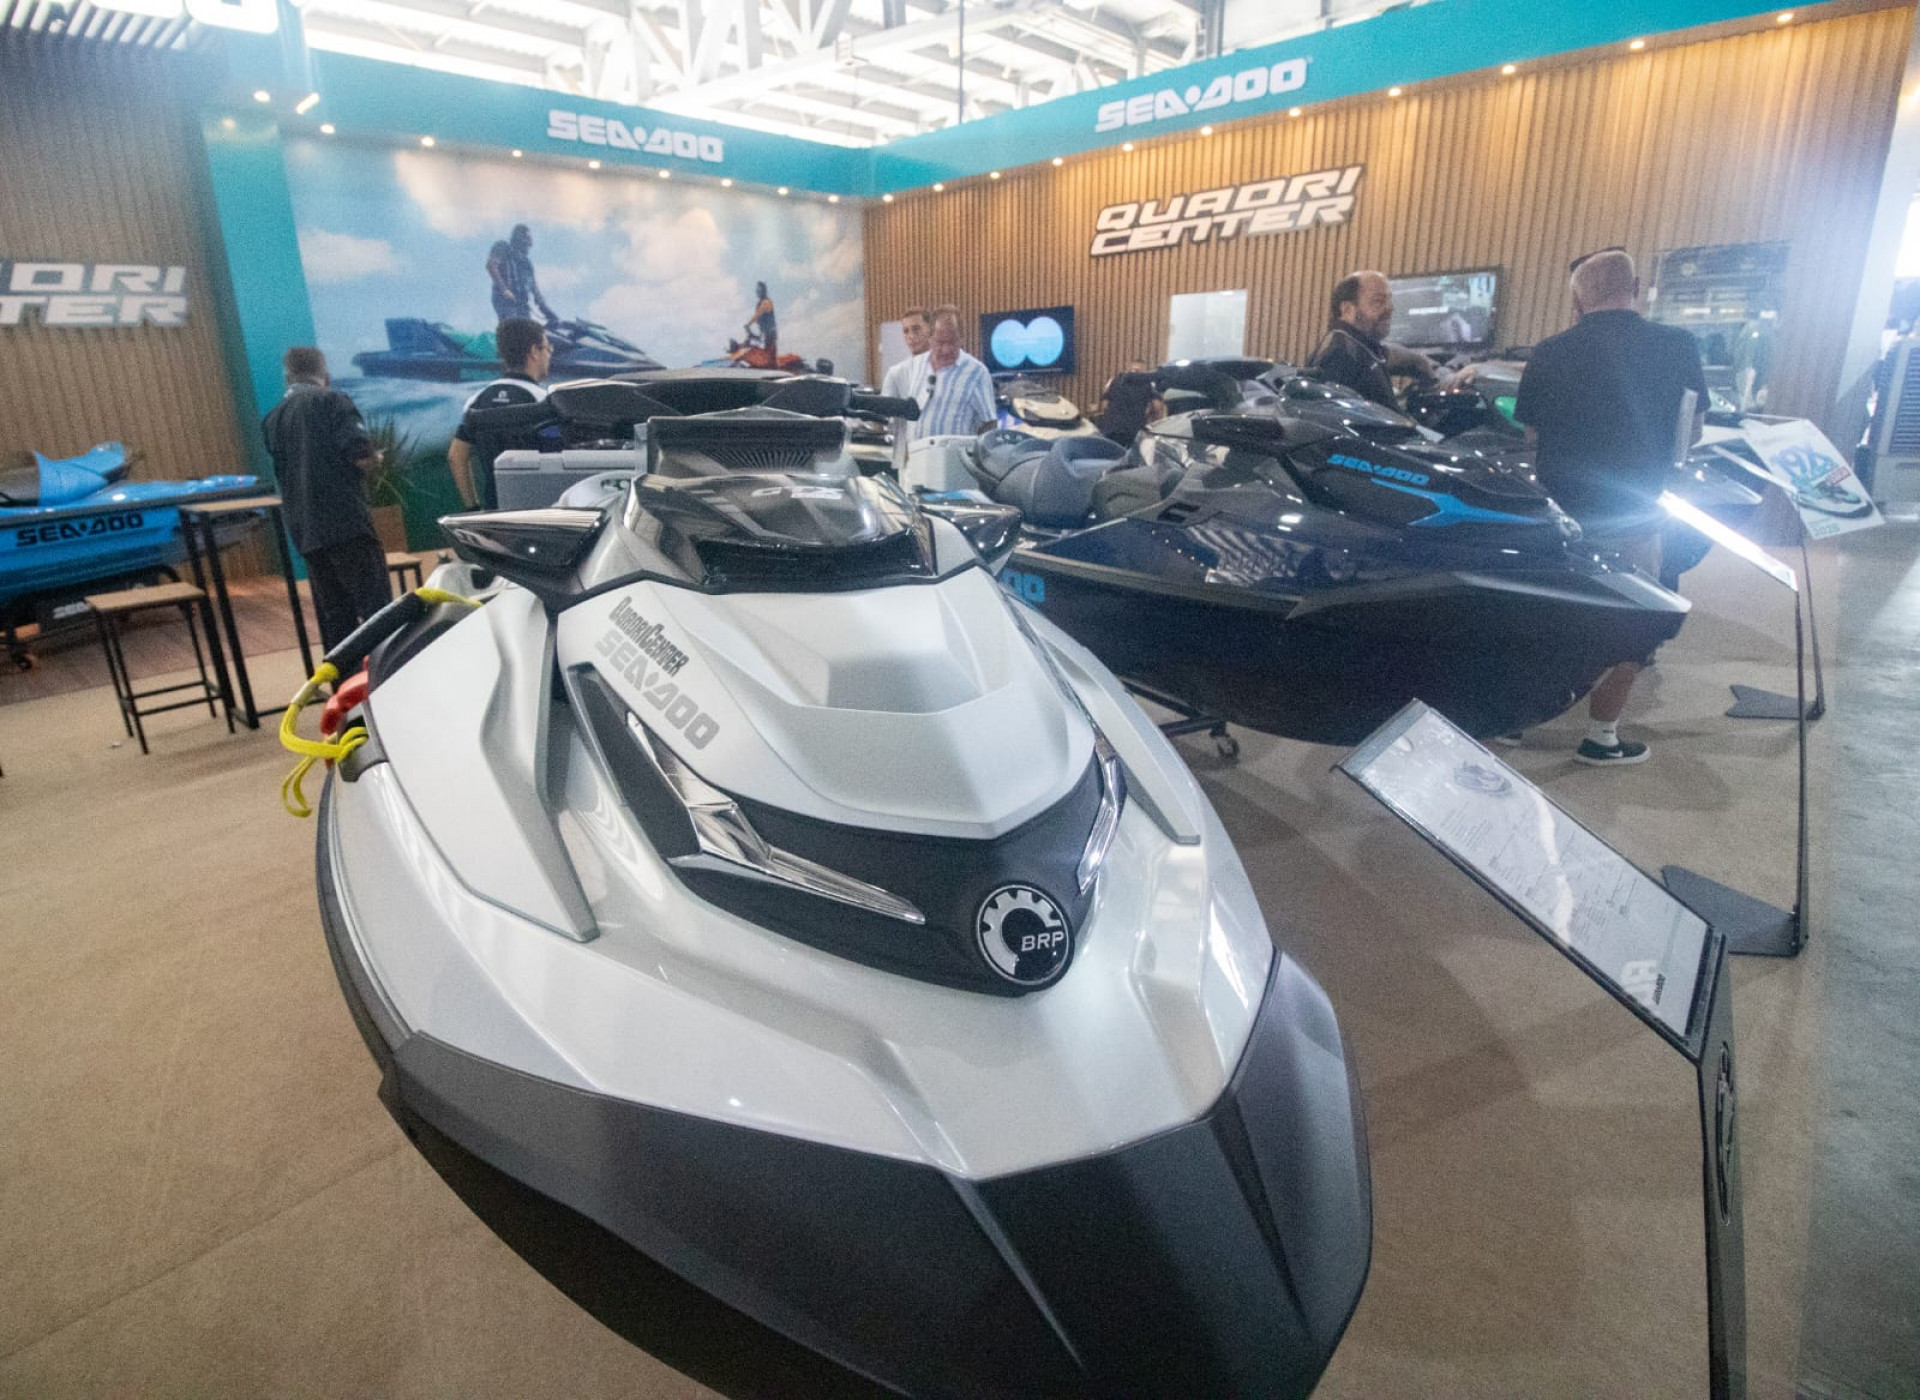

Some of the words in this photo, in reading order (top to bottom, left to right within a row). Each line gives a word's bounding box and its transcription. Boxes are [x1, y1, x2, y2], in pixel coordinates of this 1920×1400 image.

[1095, 165, 1364, 231] QUADRI
[1090, 195, 1355, 257] CENTER
[0, 262, 187, 293] DRI
[1021, 931, 1064, 952] BRP
